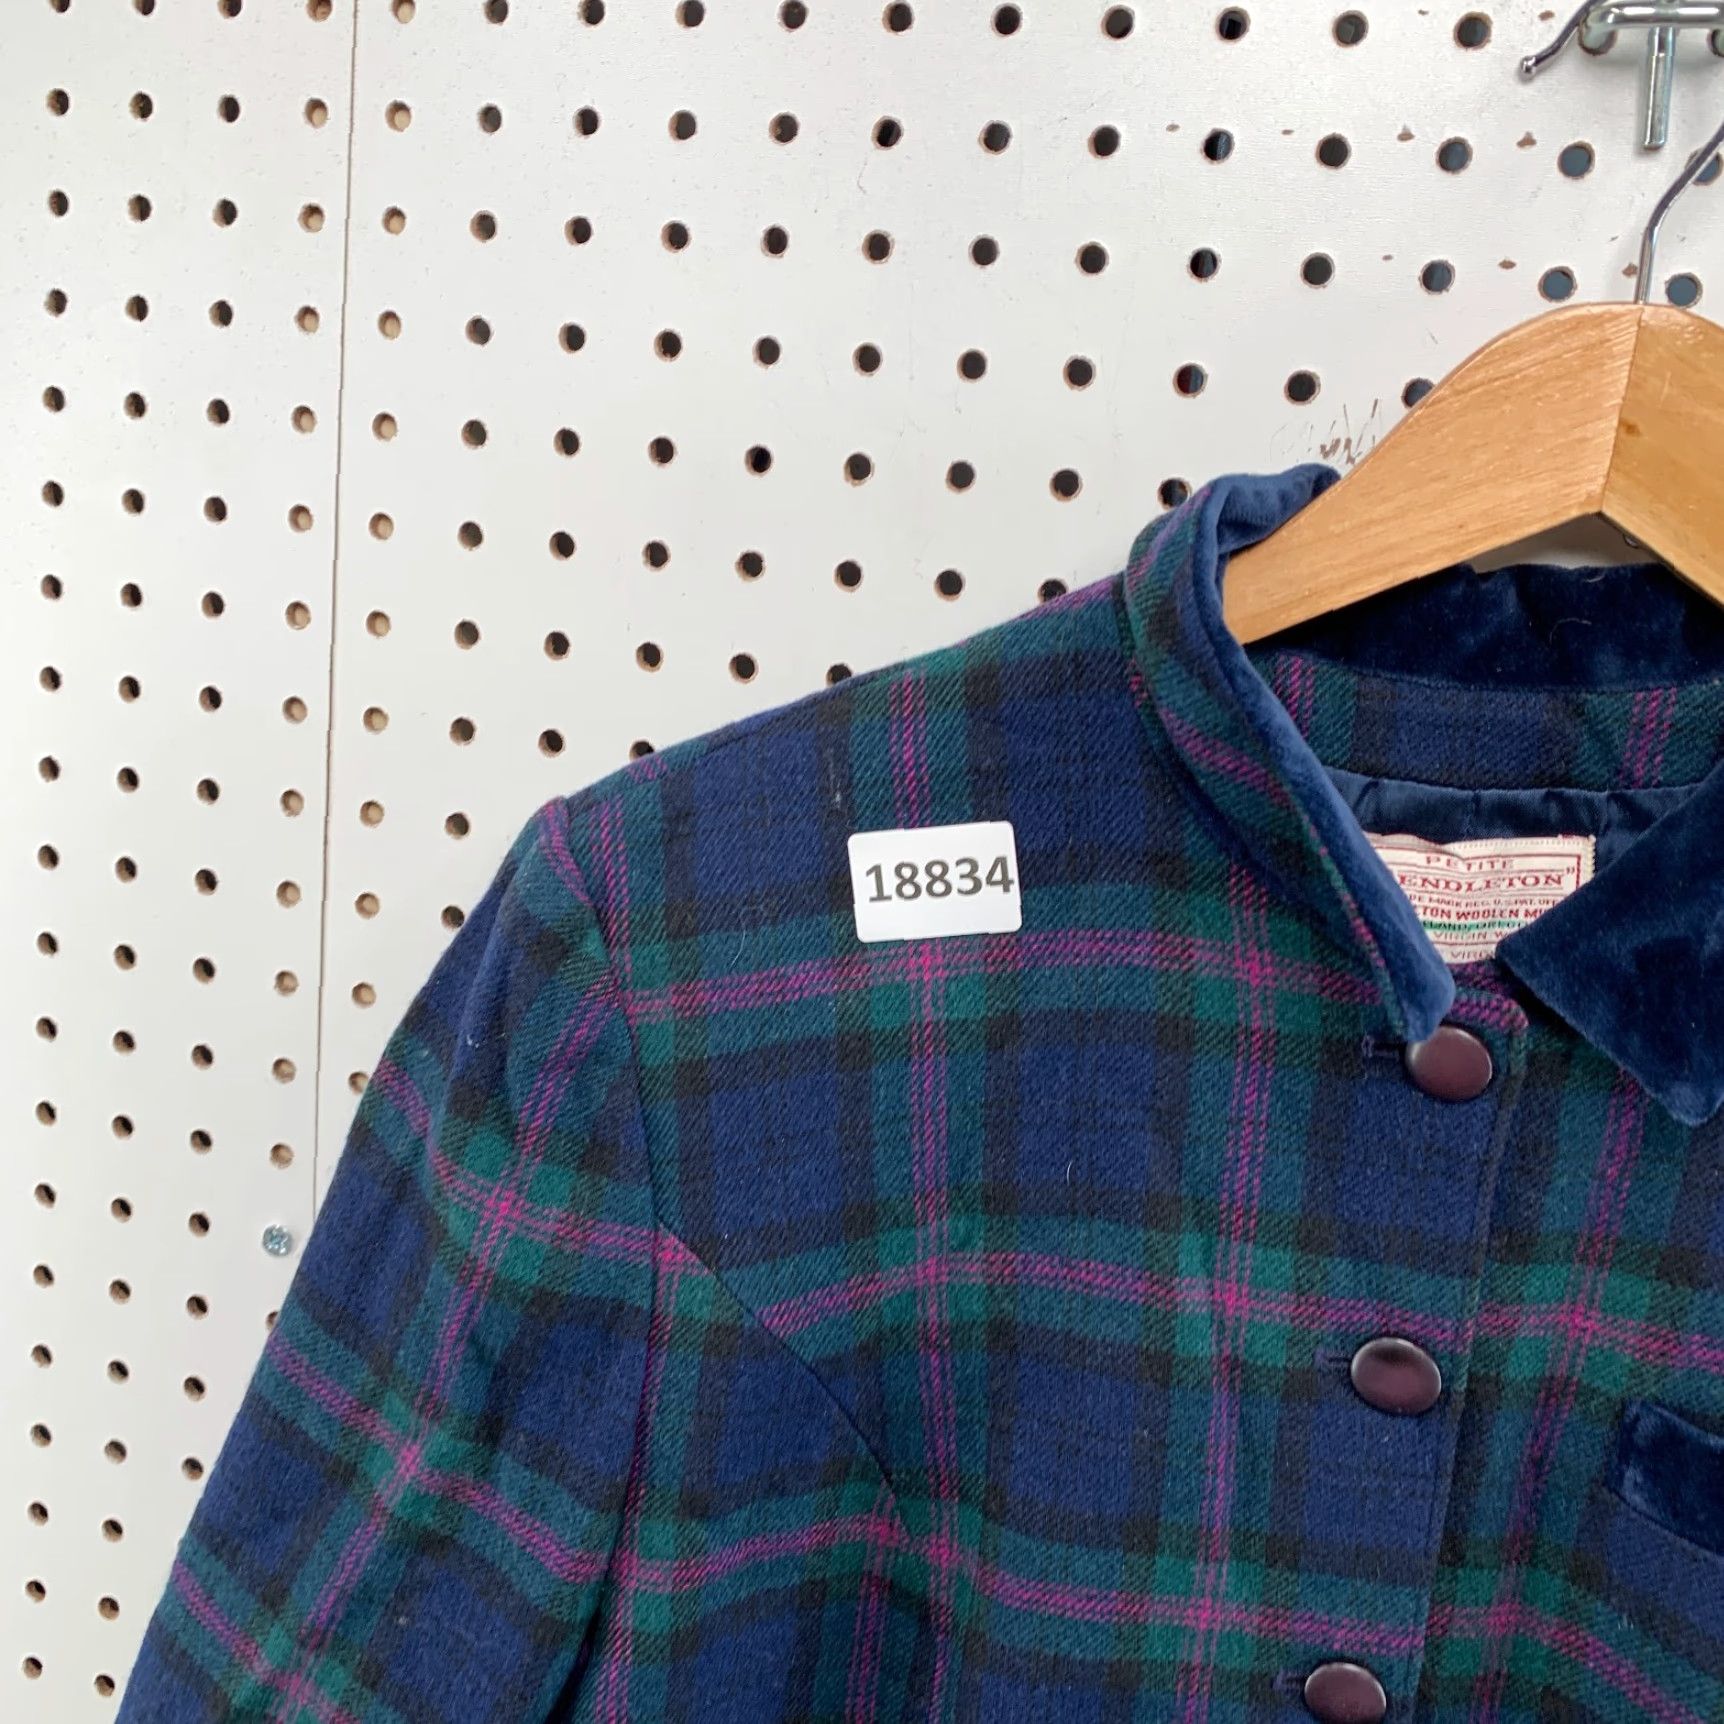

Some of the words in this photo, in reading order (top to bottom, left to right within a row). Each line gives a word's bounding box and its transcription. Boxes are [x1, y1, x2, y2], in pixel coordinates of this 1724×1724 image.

[1425, 856, 1515, 872] PETITE
[865, 855, 1014, 902] 18834
[1455, 907, 1519, 921] WOOLEN
[1524, 906, 1547, 919] MI
